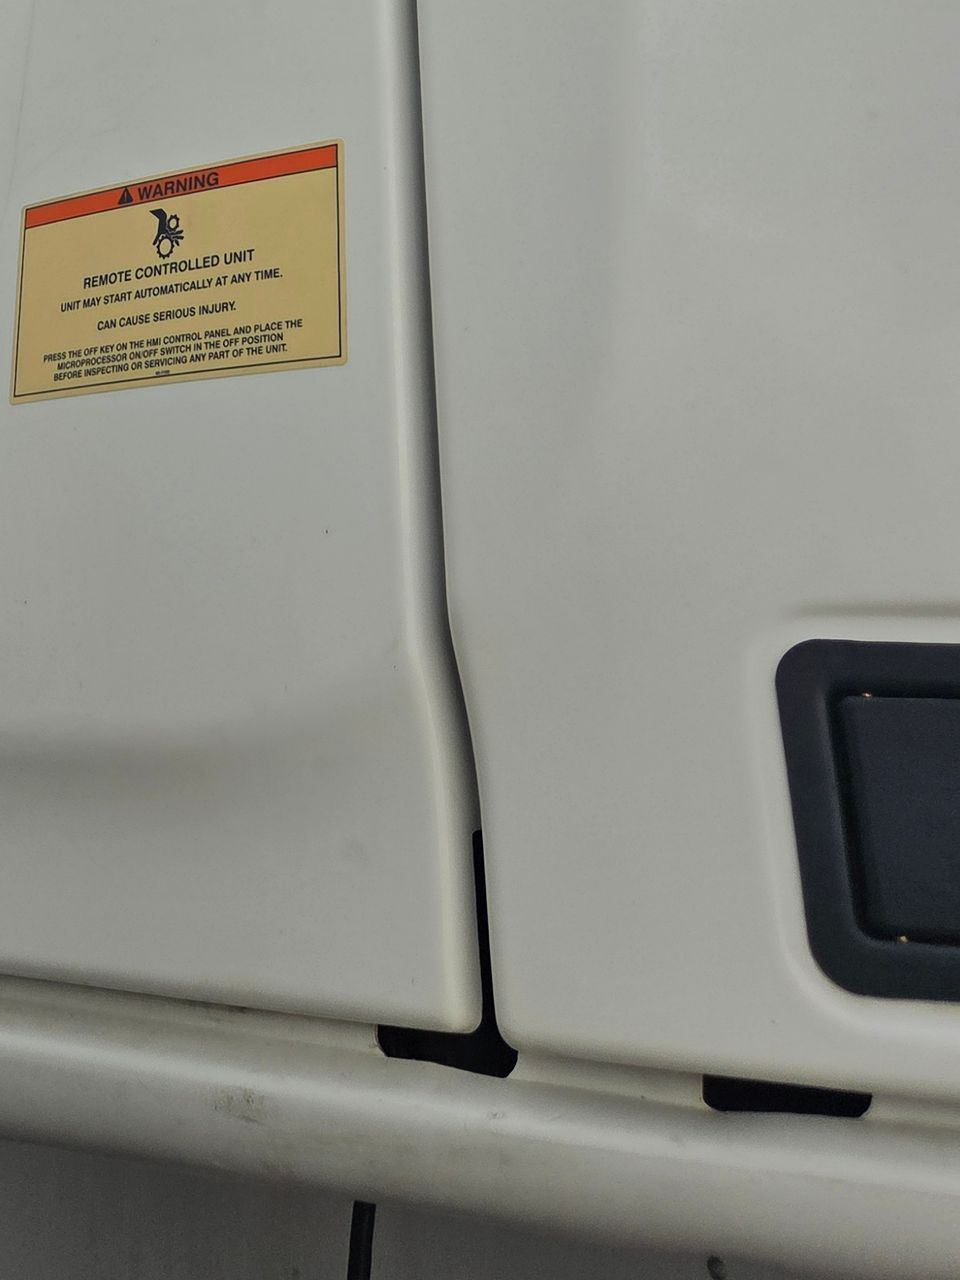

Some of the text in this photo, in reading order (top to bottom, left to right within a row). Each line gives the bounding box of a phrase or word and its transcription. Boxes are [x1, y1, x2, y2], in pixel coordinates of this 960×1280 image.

[138, 172, 219, 200] WARNING
[84, 249, 255, 289] REMOTE CONTROLLED UNIT
[61, 268, 283, 312] UNIT MAY START AUTOMATICALLY AT ANY TIME.
[97, 301, 236, 330] CAN CAUSE SERIOUS INJURY.
[44, 319, 303, 362] PRESS THE OFF KEY ON THE HMI CONTROL PANEL AND PLACE THE
[57, 353, 127, 370] MICROPROCESSOR
[160, 344, 191, 355] SWITCH
[204, 340, 221, 349] THE
[223, 338, 240, 347] OFF
[242, 333, 283, 345] POSITION
[54, 344, 287, 381] BEFORE INSPECTING OR SERVICING ANY PART OF THE UNIT.
